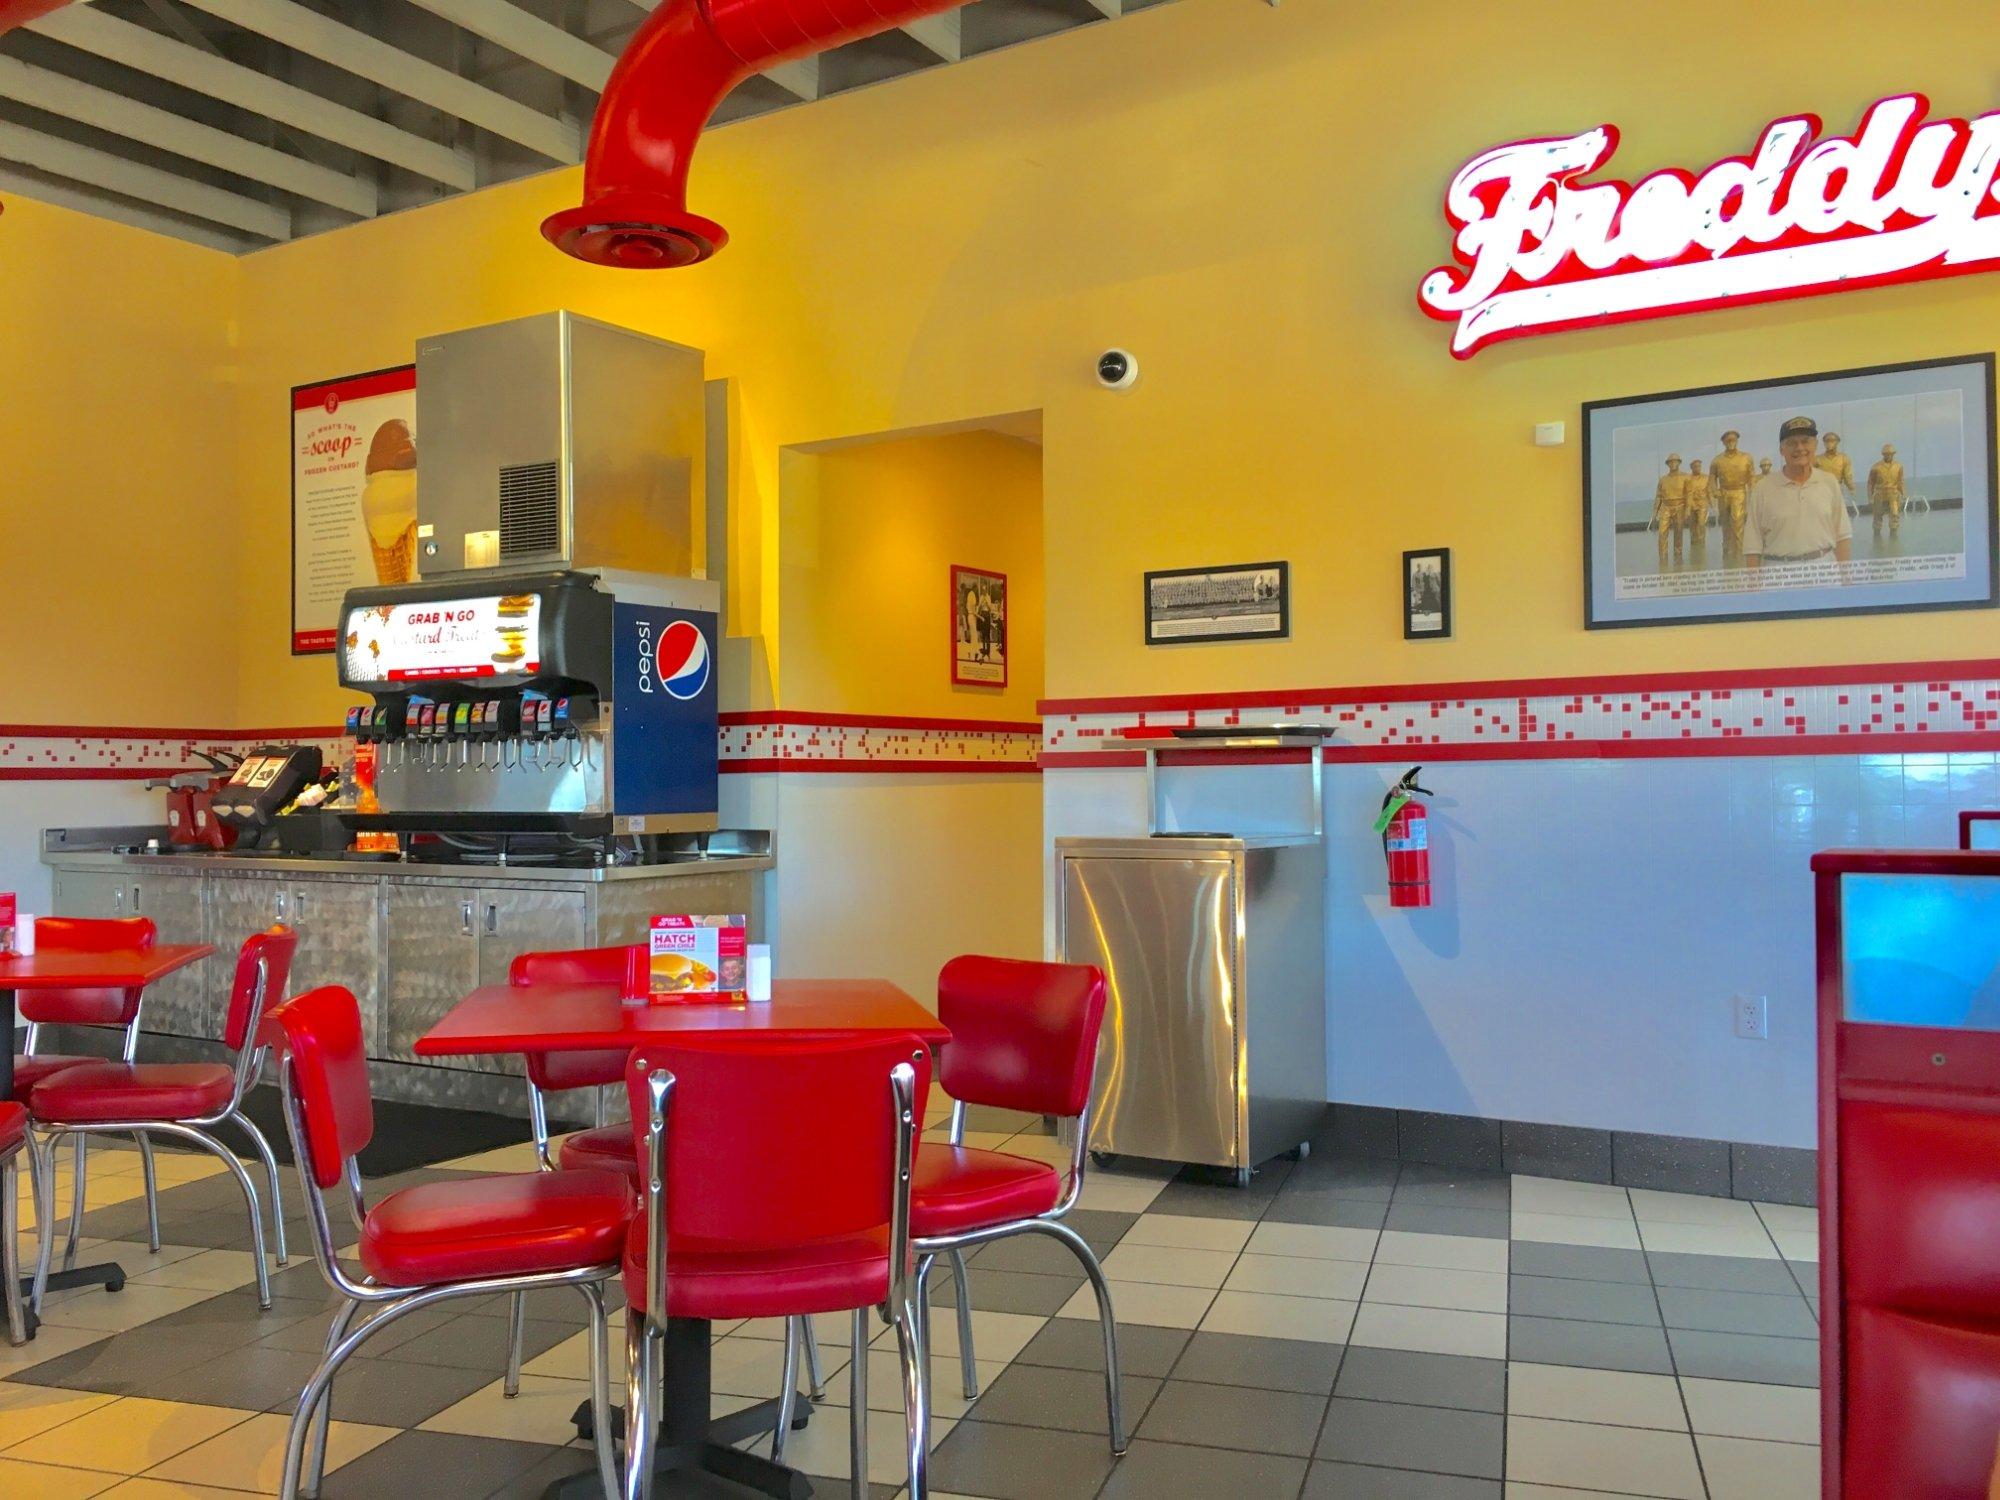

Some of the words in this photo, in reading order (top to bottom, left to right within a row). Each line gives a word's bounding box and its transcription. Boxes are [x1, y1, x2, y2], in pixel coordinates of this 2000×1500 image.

[1420, 93, 2000, 360] Freddy
[344, 424, 356, 432] THE
[310, 436, 352, 458] scoop
[408, 612, 440, 624] GRAB
[457, 610, 475, 622] GO
[636, 621, 654, 693] pepsi
[654, 934, 695, 943] HATCH
